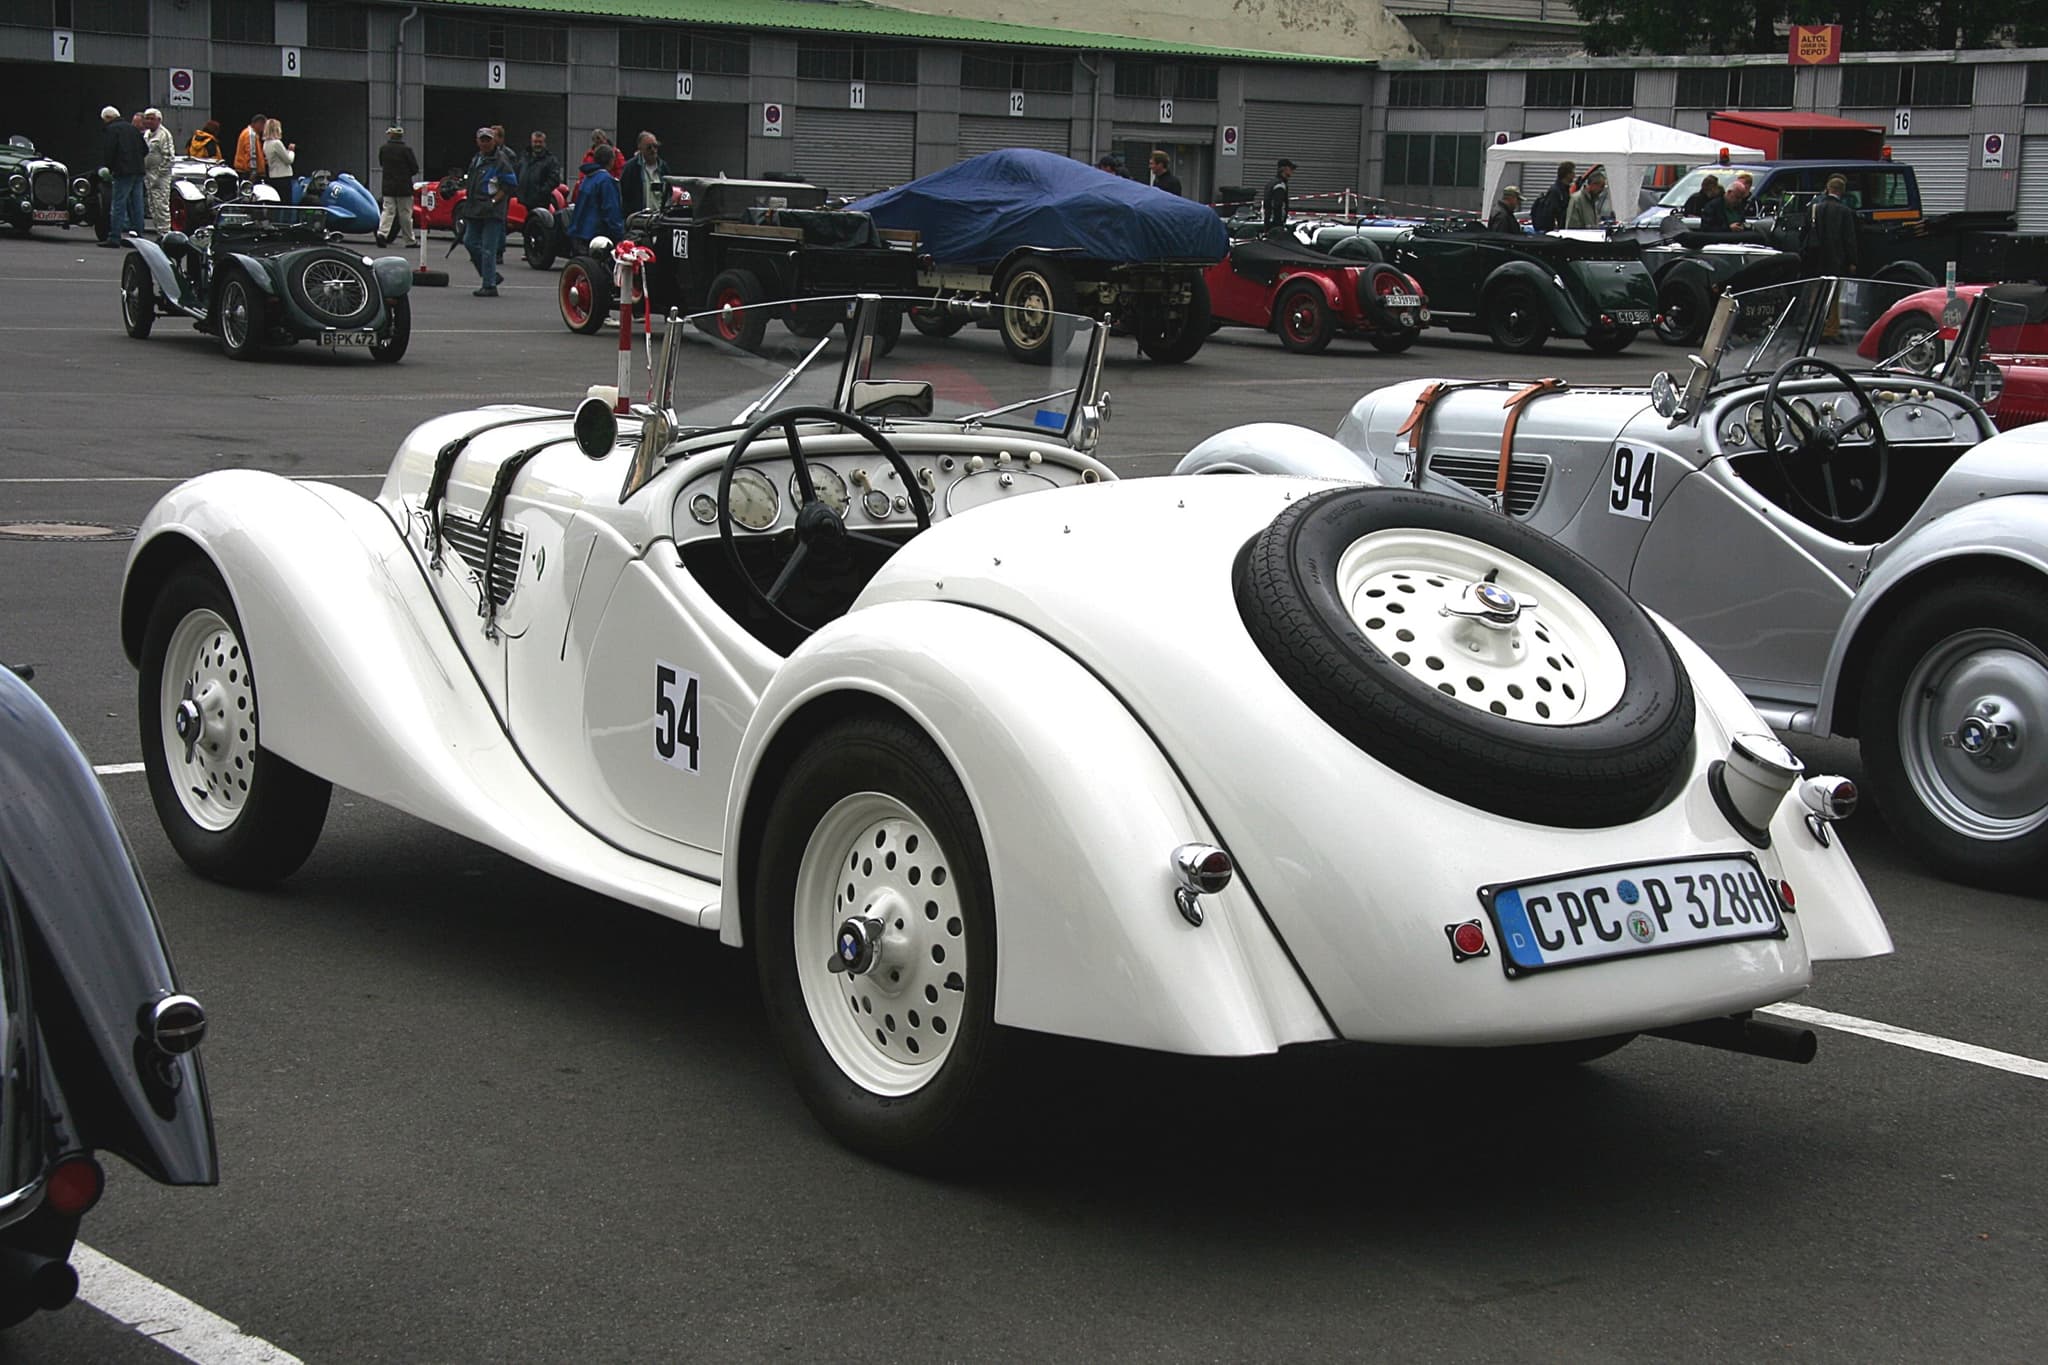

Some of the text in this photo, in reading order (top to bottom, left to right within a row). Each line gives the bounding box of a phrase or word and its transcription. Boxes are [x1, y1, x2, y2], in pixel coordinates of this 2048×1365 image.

[59, 36, 69, 56] 7
[1801, 35, 1828, 43] ALTOL
[1800, 48, 1828, 56] DEPOT
[287, 51, 297, 71] 8
[492, 64, 502, 84] 9
[677, 77, 692, 95] 10
[851, 87, 863, 104] 11
[1011, 95, 1023, 112] 12
[1160, 103, 1172, 119] 13
[1570, 112, 1582, 128] 14
[1895, 112, 1910, 130] 16
[323, 333, 375, 345] B PK 472
[1611, 447, 1656, 517] 94
[656, 663, 699, 771] 54
[1526, 887, 1623, 951] CPC
[1513, 932, 1526, 949] D
